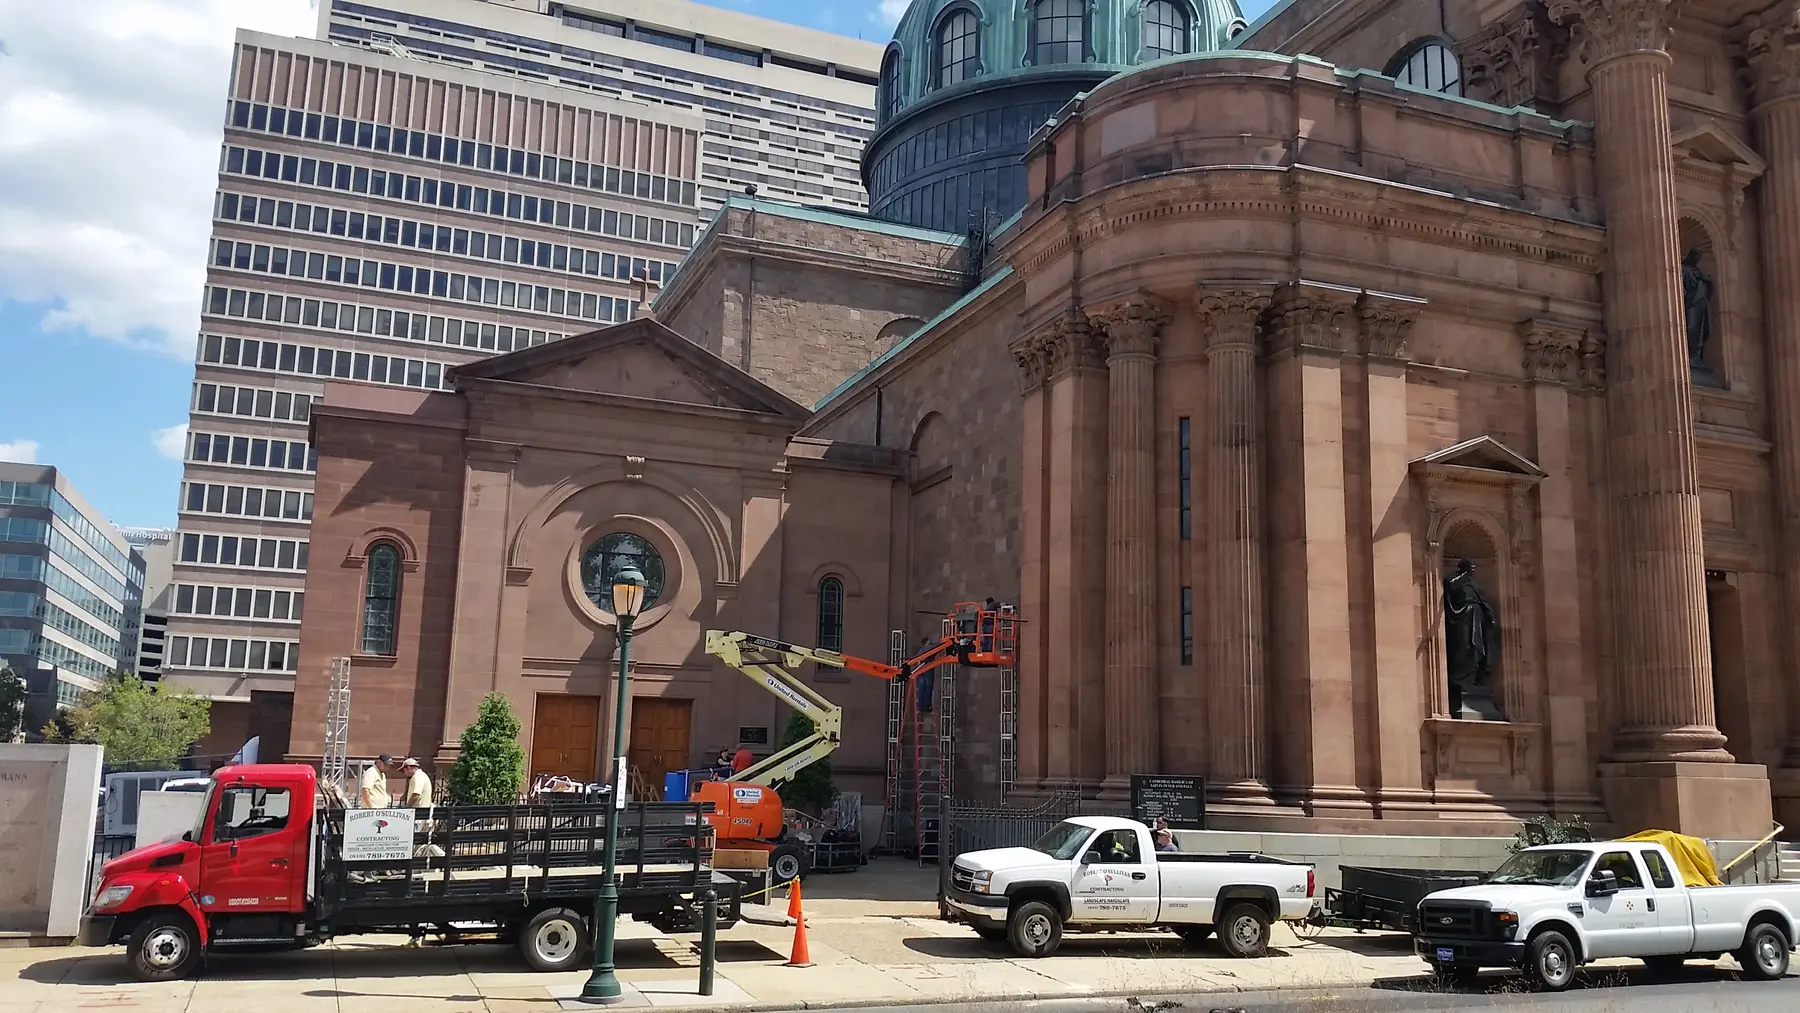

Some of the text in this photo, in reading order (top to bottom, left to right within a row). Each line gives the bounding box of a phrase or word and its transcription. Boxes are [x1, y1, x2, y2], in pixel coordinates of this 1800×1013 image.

[136, 532, 171, 540] Hospital
[773, 683, 807, 709] United Rentals
[350, 810, 411, 822] ROBERT O'SULLIVAN
